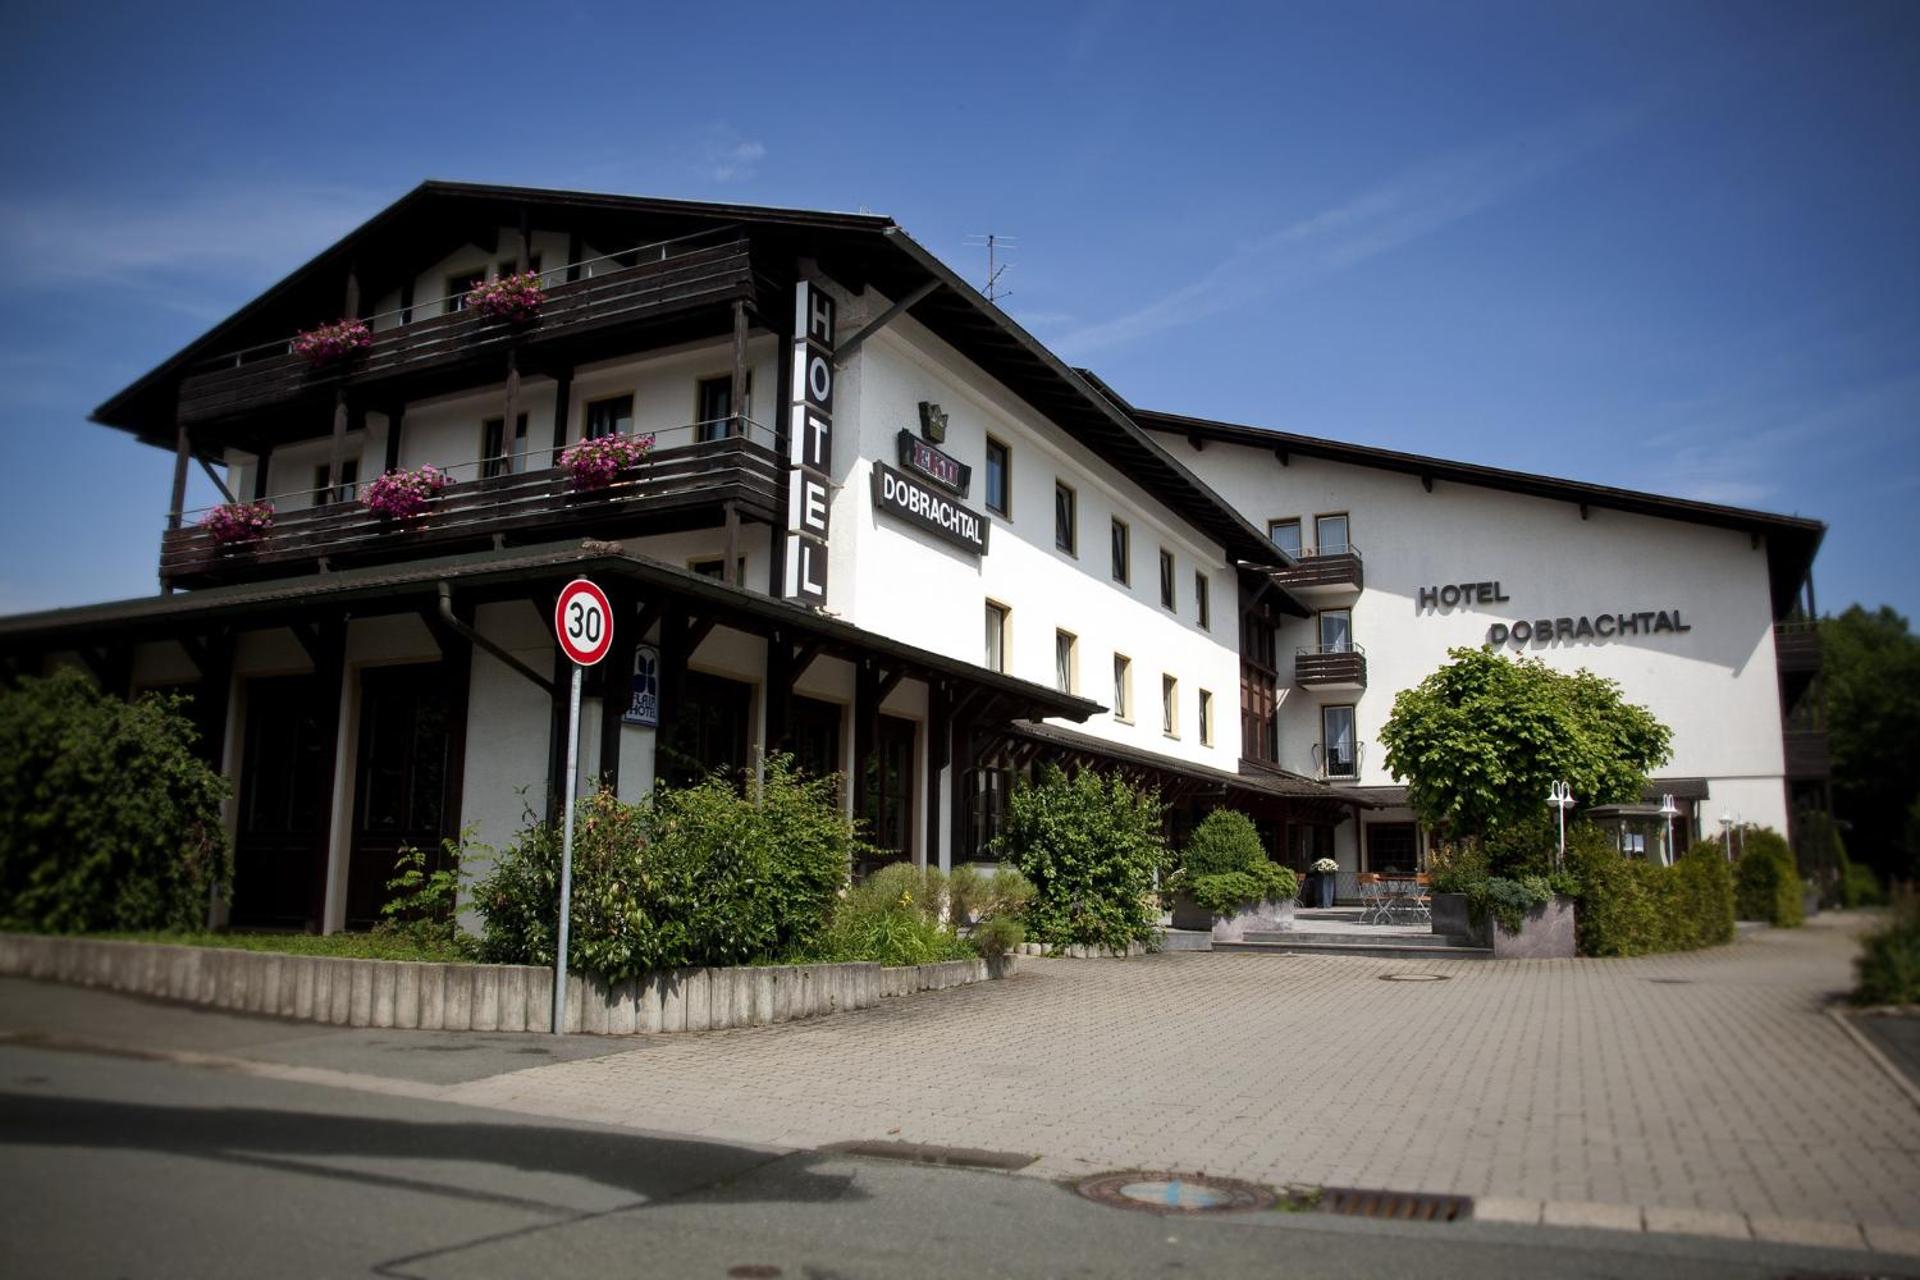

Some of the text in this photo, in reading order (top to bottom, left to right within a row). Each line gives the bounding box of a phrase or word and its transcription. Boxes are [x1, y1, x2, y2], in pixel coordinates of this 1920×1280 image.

[803, 291, 831, 596] HOTEL
[883, 472, 983, 545] DOBRACHTAL
[1419, 581, 1510, 608] HOTEL
[568, 601, 601, 643] 30
[1489, 610, 1692, 645] DOBRACHTAL
